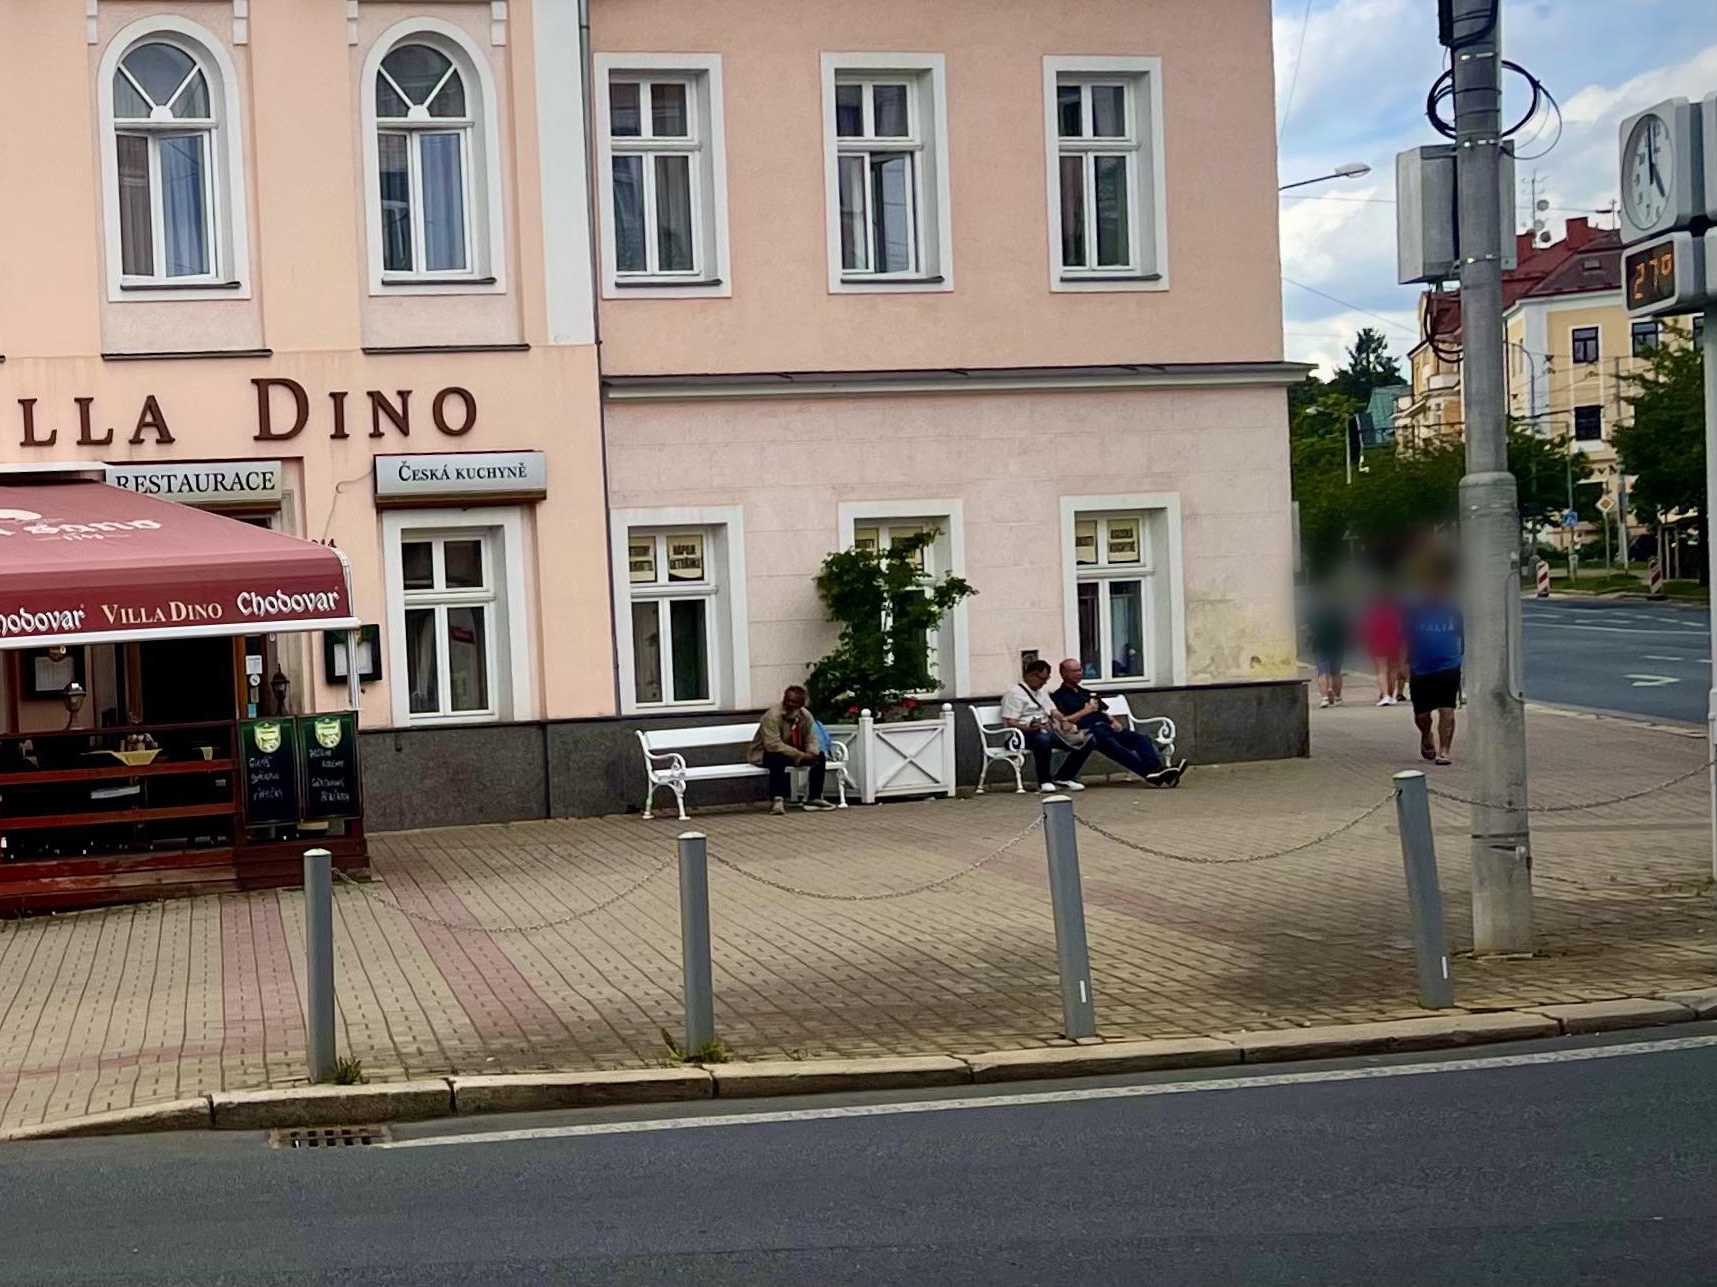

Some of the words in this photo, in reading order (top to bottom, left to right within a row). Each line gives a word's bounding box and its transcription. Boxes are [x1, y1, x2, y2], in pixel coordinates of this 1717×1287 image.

[251, 377, 477, 442] DINO
[115, 470, 276, 495] RESTAURACE
[398, 460, 451, 482] ČESKÁ
[455, 462, 528, 480] KUCHYNĚ
[101, 604, 162, 625] VILLA
[170, 600, 223, 622] DINO
[236, 587, 338, 617] Chodovar
